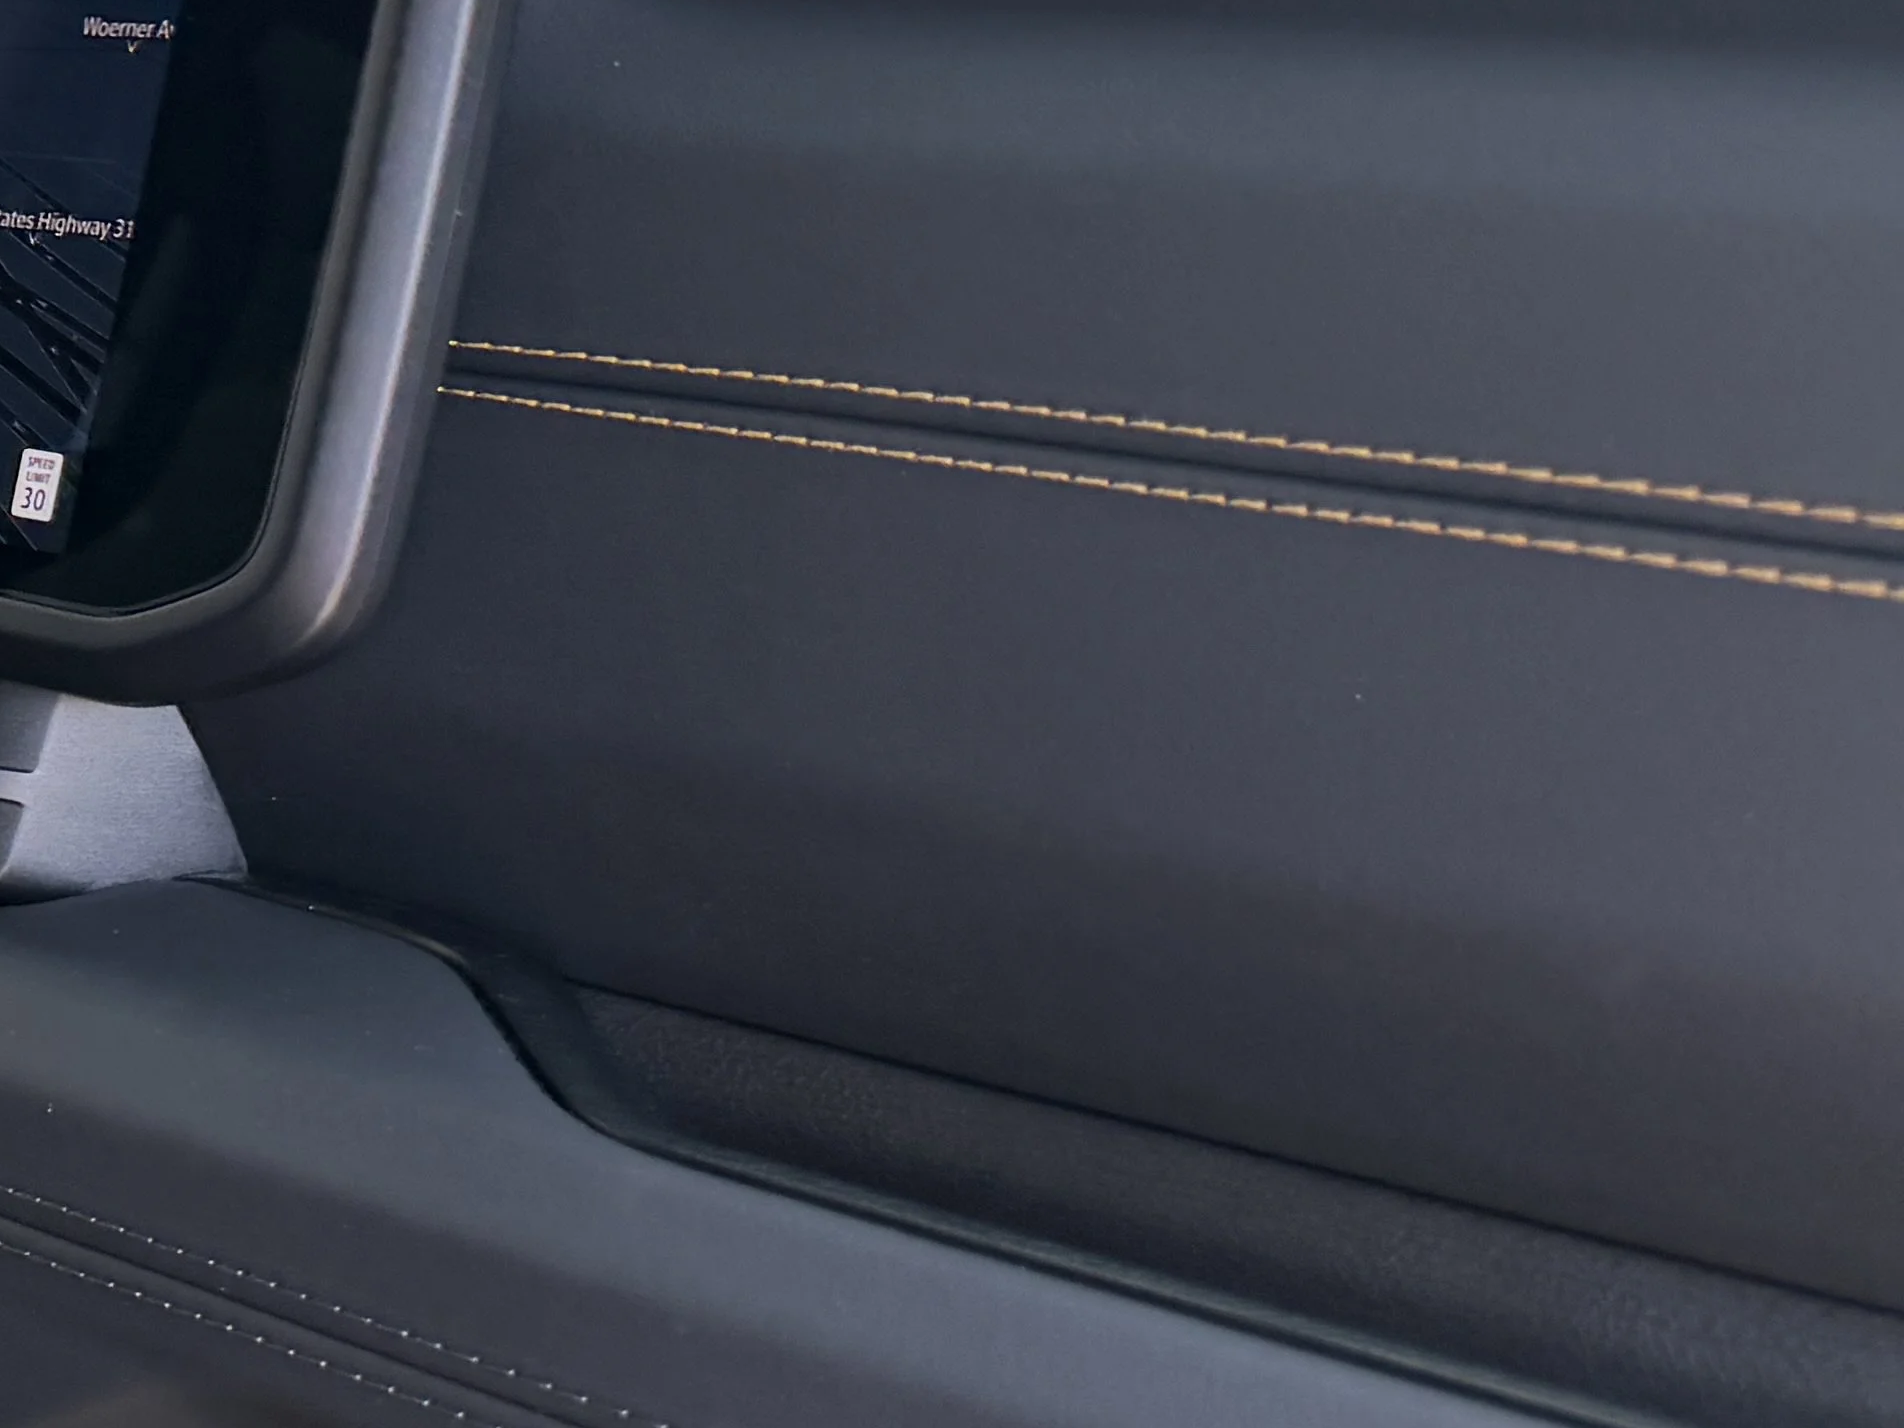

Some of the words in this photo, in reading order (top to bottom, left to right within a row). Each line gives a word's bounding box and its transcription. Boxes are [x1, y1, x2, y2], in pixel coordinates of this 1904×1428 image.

[83, 16, 153, 39] Woerner
[38, 211, 112, 241] Highway
[112, 217, 135, 240] 31
[28, 456, 56, 470] SPEED
[26, 471, 51, 485] LIMIT
[20, 487, 46, 511] 30
